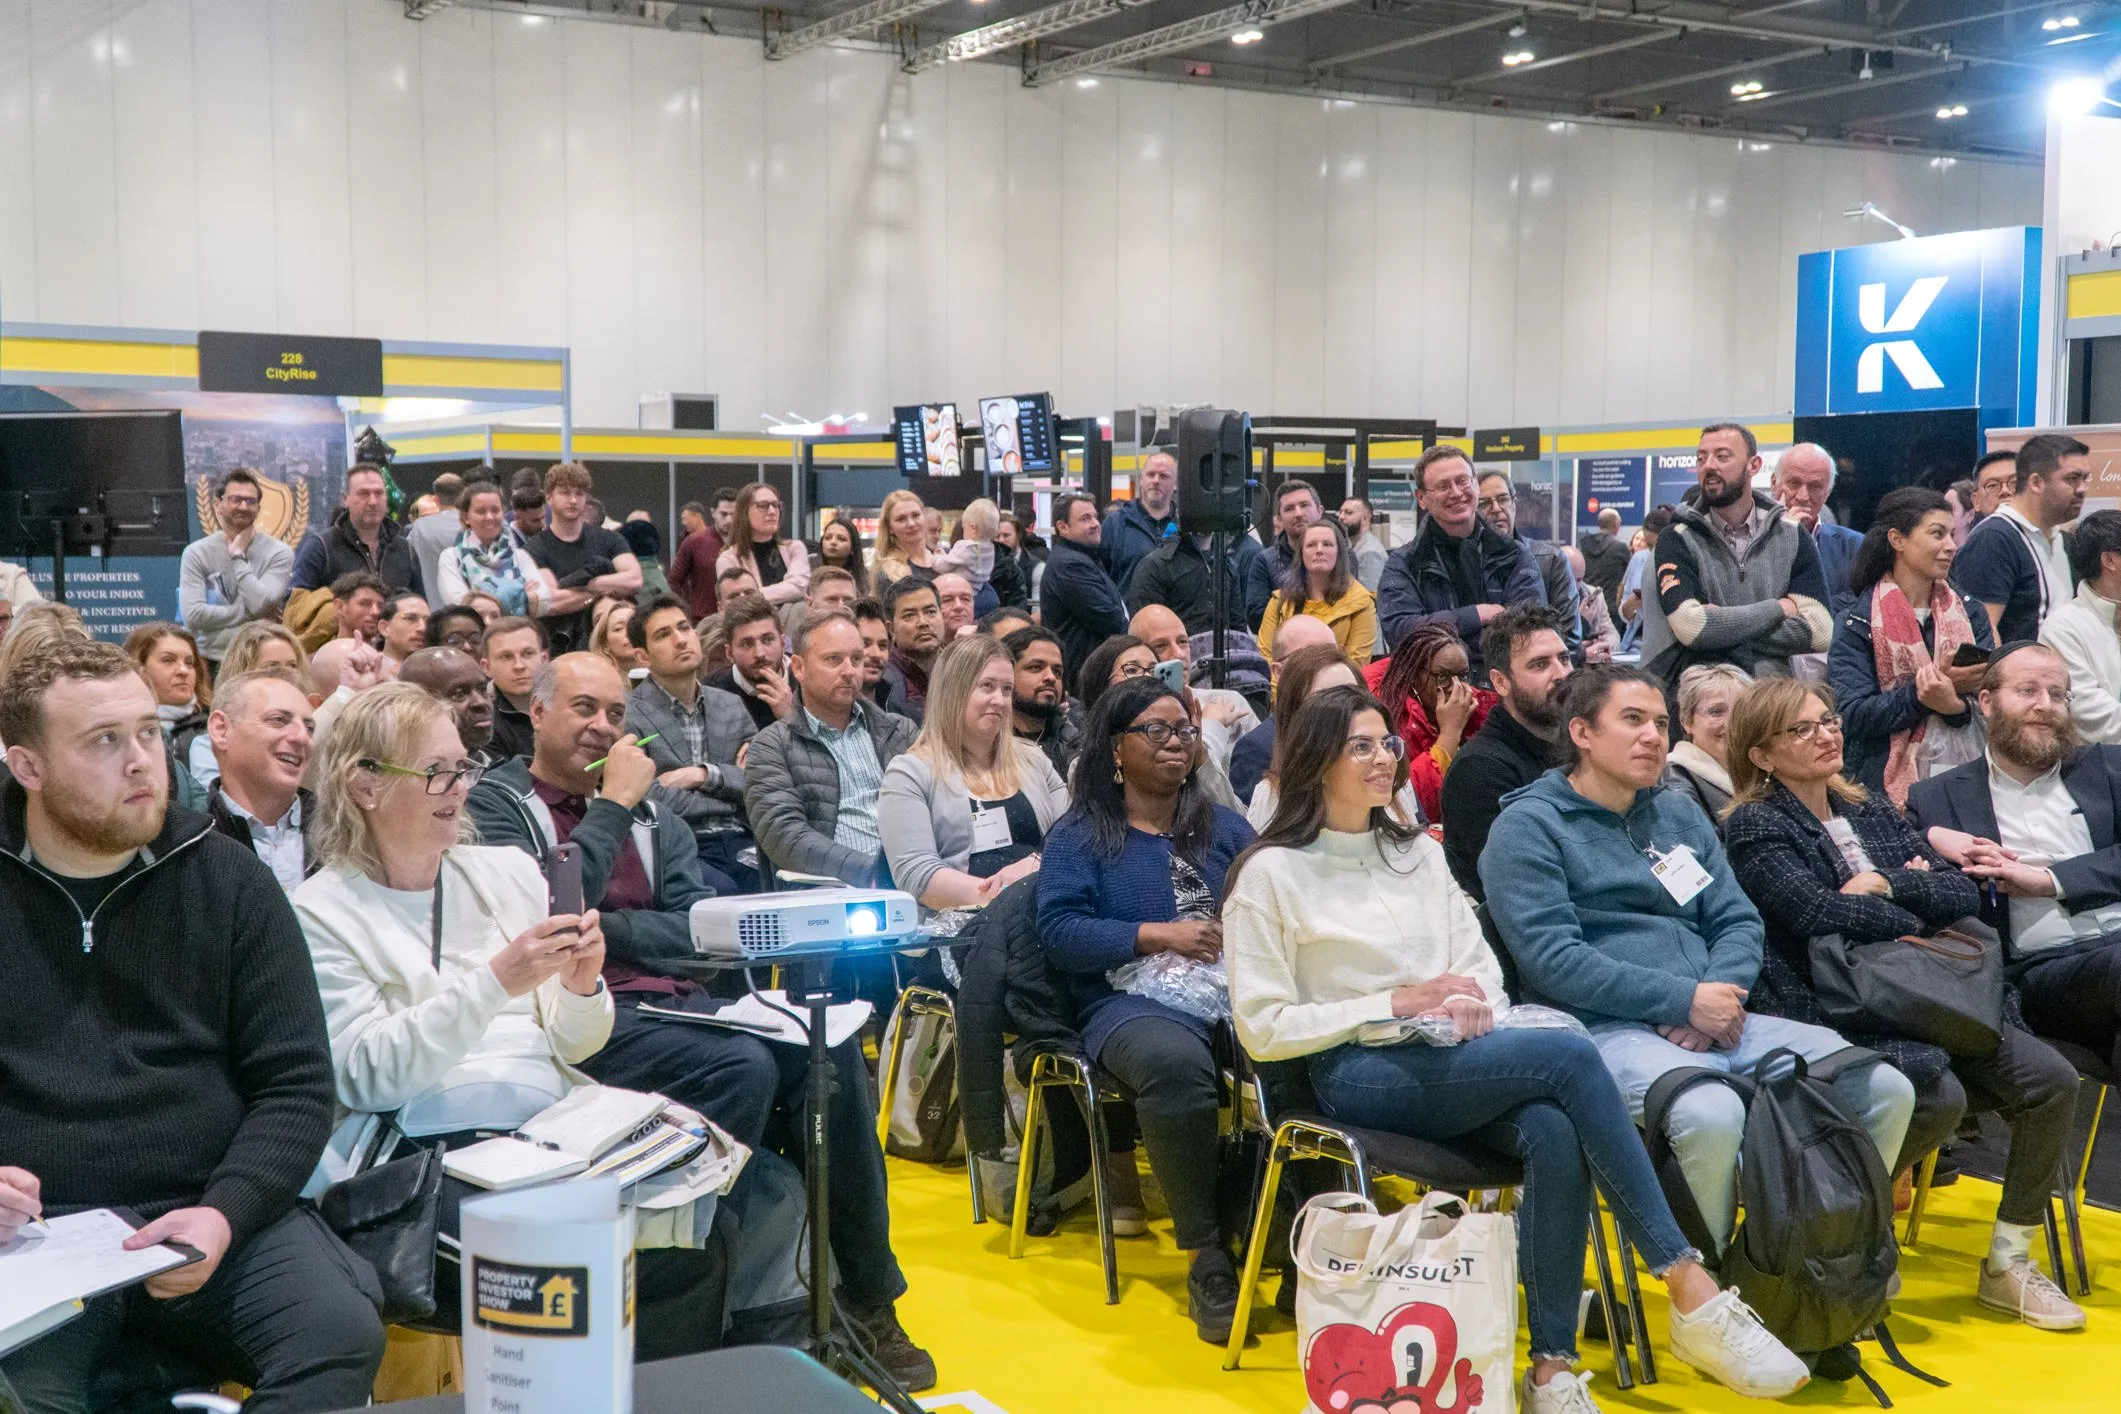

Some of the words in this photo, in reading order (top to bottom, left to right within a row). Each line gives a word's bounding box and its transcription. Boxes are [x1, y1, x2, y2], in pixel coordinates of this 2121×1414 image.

[1857, 276, 1949, 393] K
[281, 352, 303, 365] 228
[265, 367, 318, 382] CityRise
[1531, 480, 1553, 491] horizo
[73, 572, 140, 582] PROPERTIES
[76, 590, 108, 600] YOUR
[109, 590, 144, 600] INBOX
[81, 608, 89, 617] &
[91, 607, 156, 617] INCENTIVES
[808, 919, 829, 927] EPSON
[927, 1111, 940, 1120] 32
[478, 1267, 538, 1287] PROPERTY
[478, 1282, 533, 1301] INVESTOR
[478, 1294, 511, 1310] SHOW
[494, 1344, 525, 1362] Hand
[491, 1397, 519, 1413] Point
